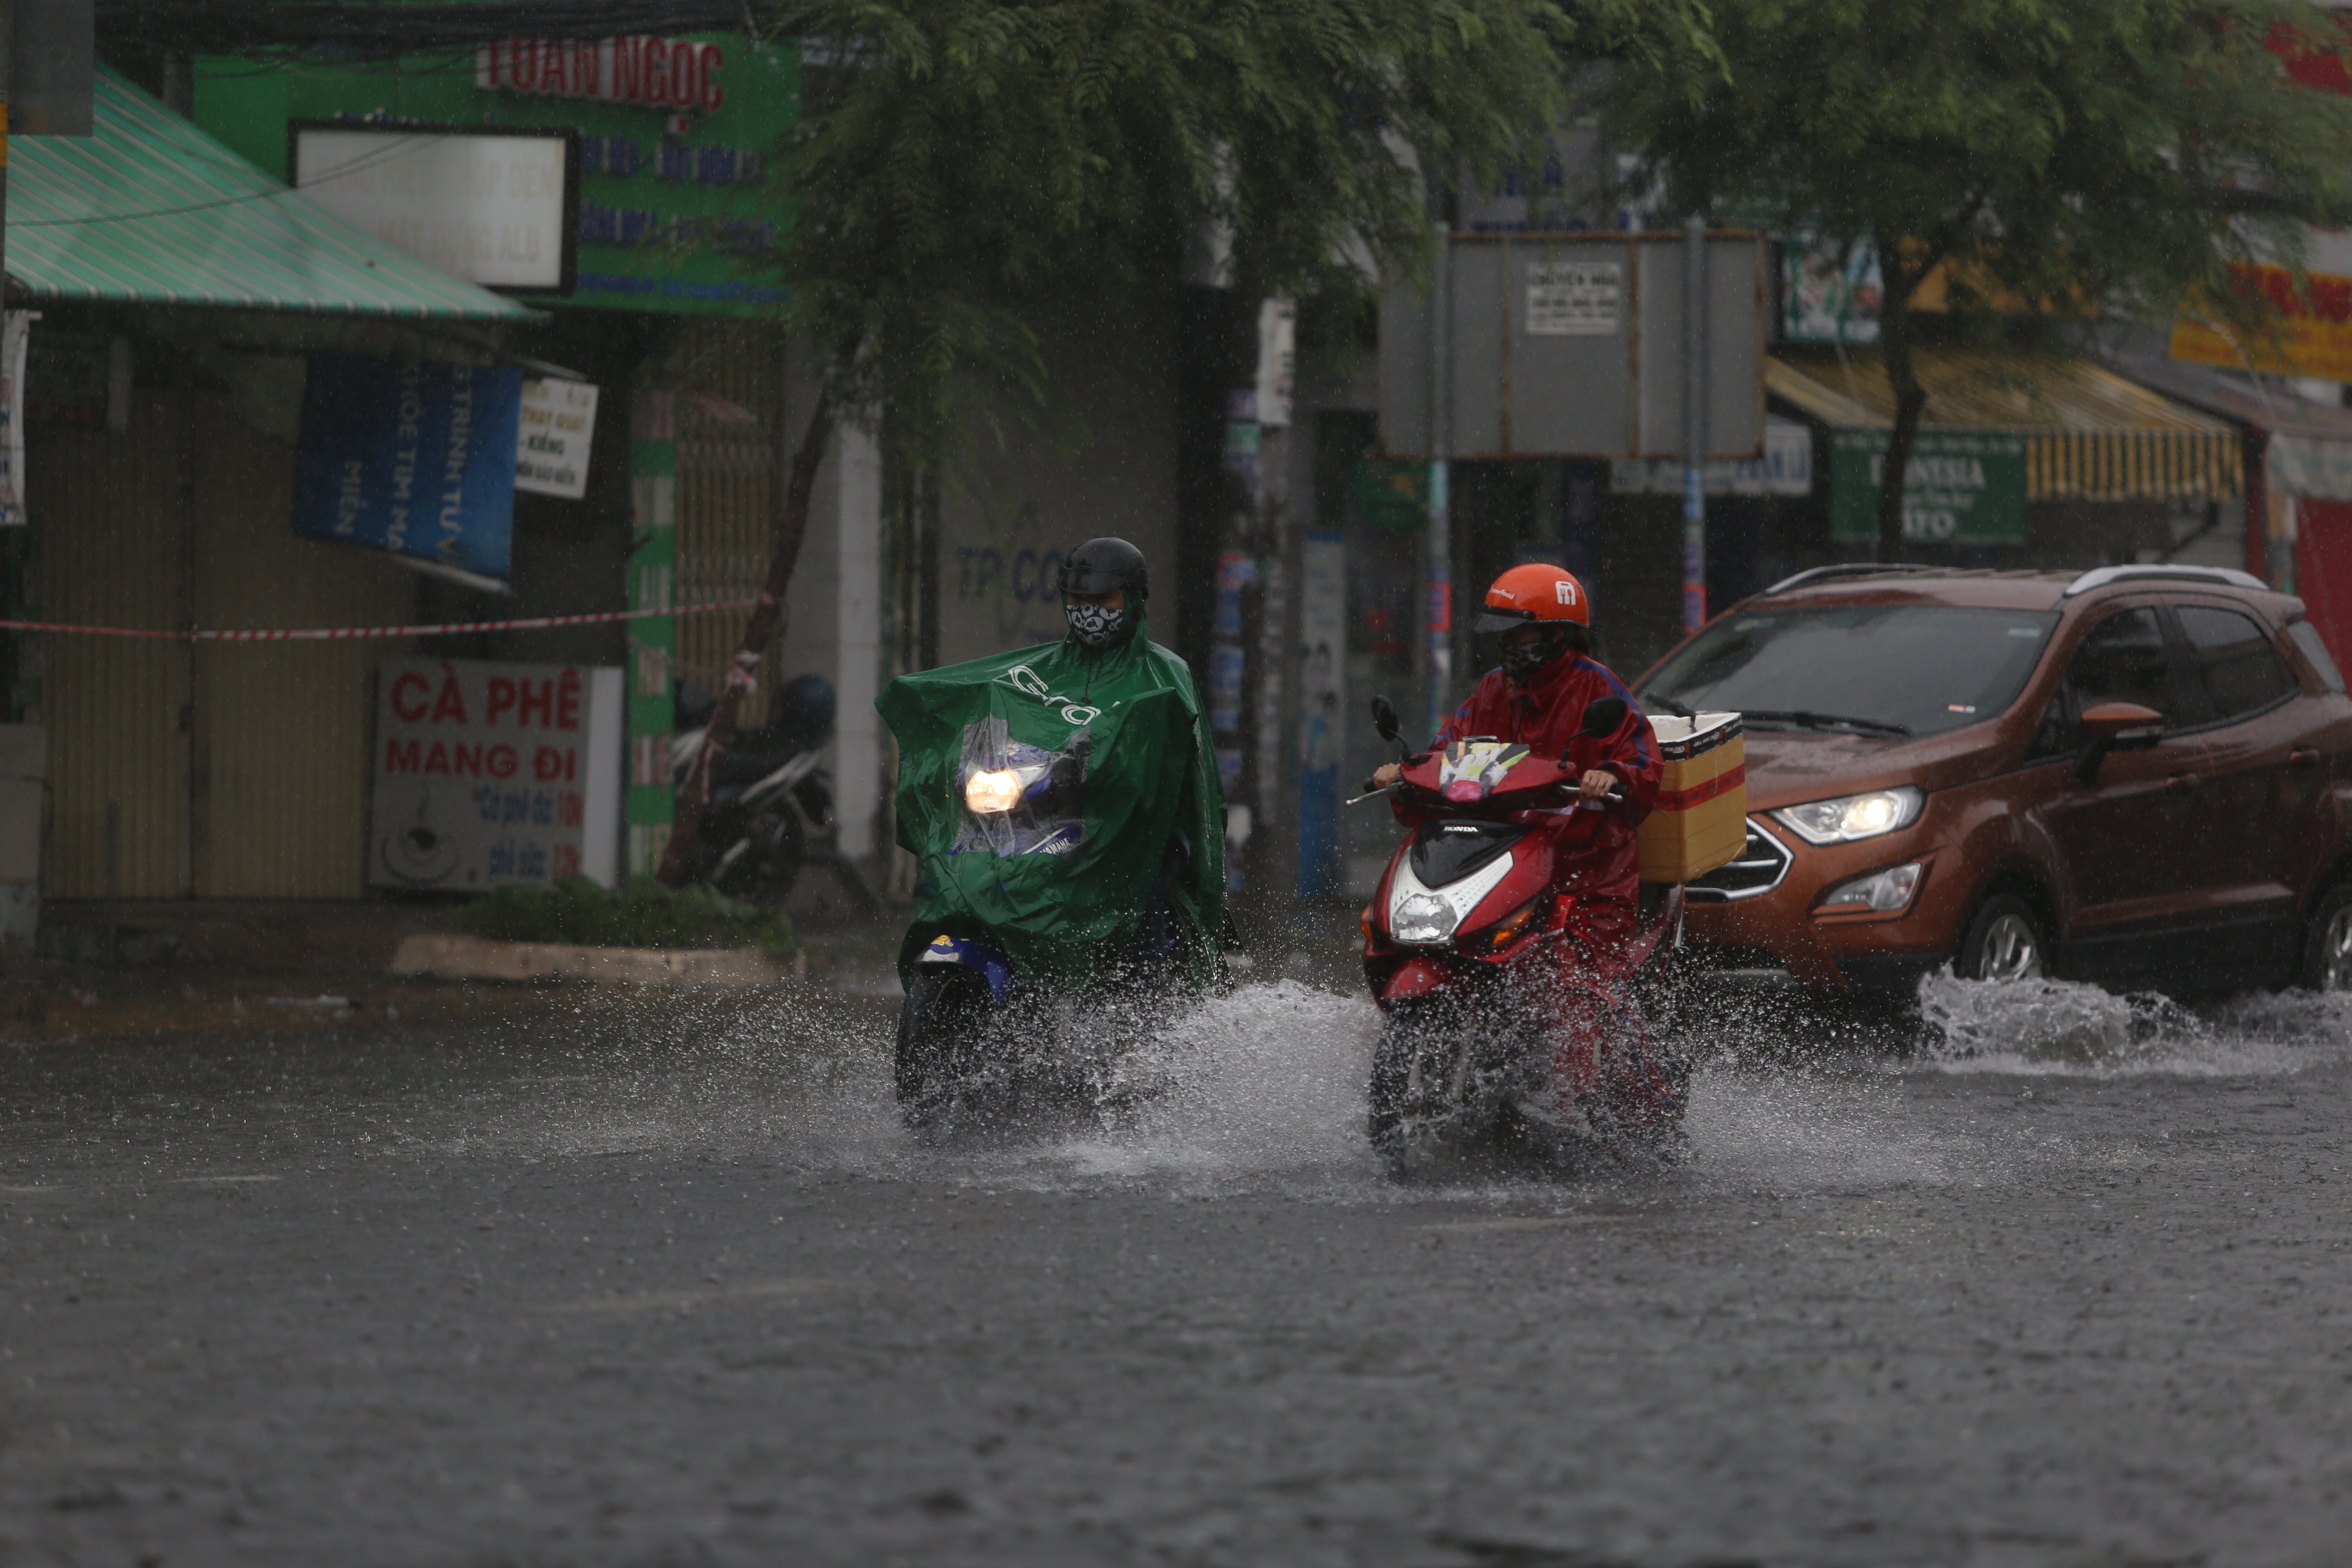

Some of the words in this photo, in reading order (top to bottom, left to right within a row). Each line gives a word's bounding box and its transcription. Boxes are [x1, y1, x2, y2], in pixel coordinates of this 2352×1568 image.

[609, 36, 724, 132] NGỌC
[390, 659, 469, 725] CÀ
[486, 666, 582, 732] PHÊ
[385, 737, 520, 779] MANG
[532, 745, 576, 783] ĐI
[1039, 837, 1071, 854] AMAHA
[1443, 824, 1479, 833] HONDA
